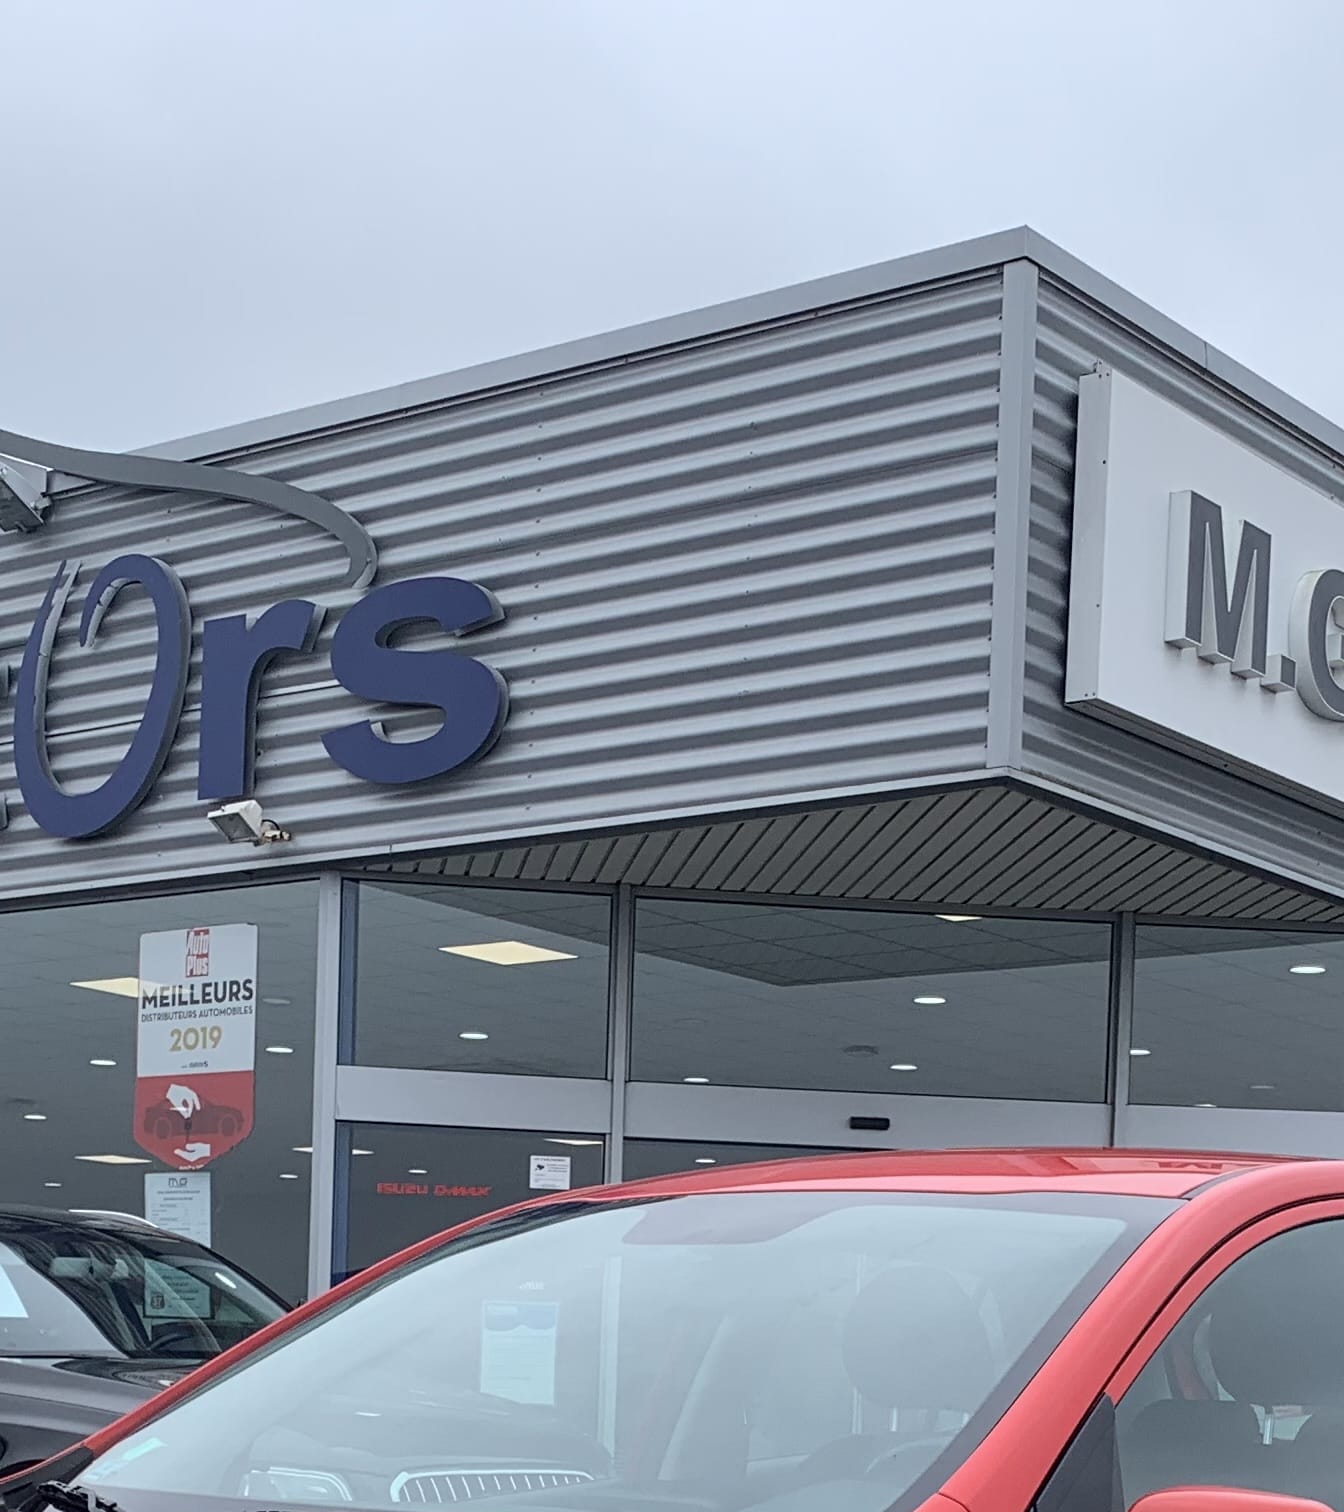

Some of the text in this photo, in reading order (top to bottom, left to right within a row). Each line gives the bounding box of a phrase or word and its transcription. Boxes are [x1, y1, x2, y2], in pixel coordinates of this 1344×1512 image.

[142, 979, 254, 1010] MEILLEURS
[141, 1005, 253, 1023] DISTRIBUTEURS AUTOMOBILES
[170, 1025, 222, 1052] 2019
[376, 1183, 429, 1195] ISUZU
